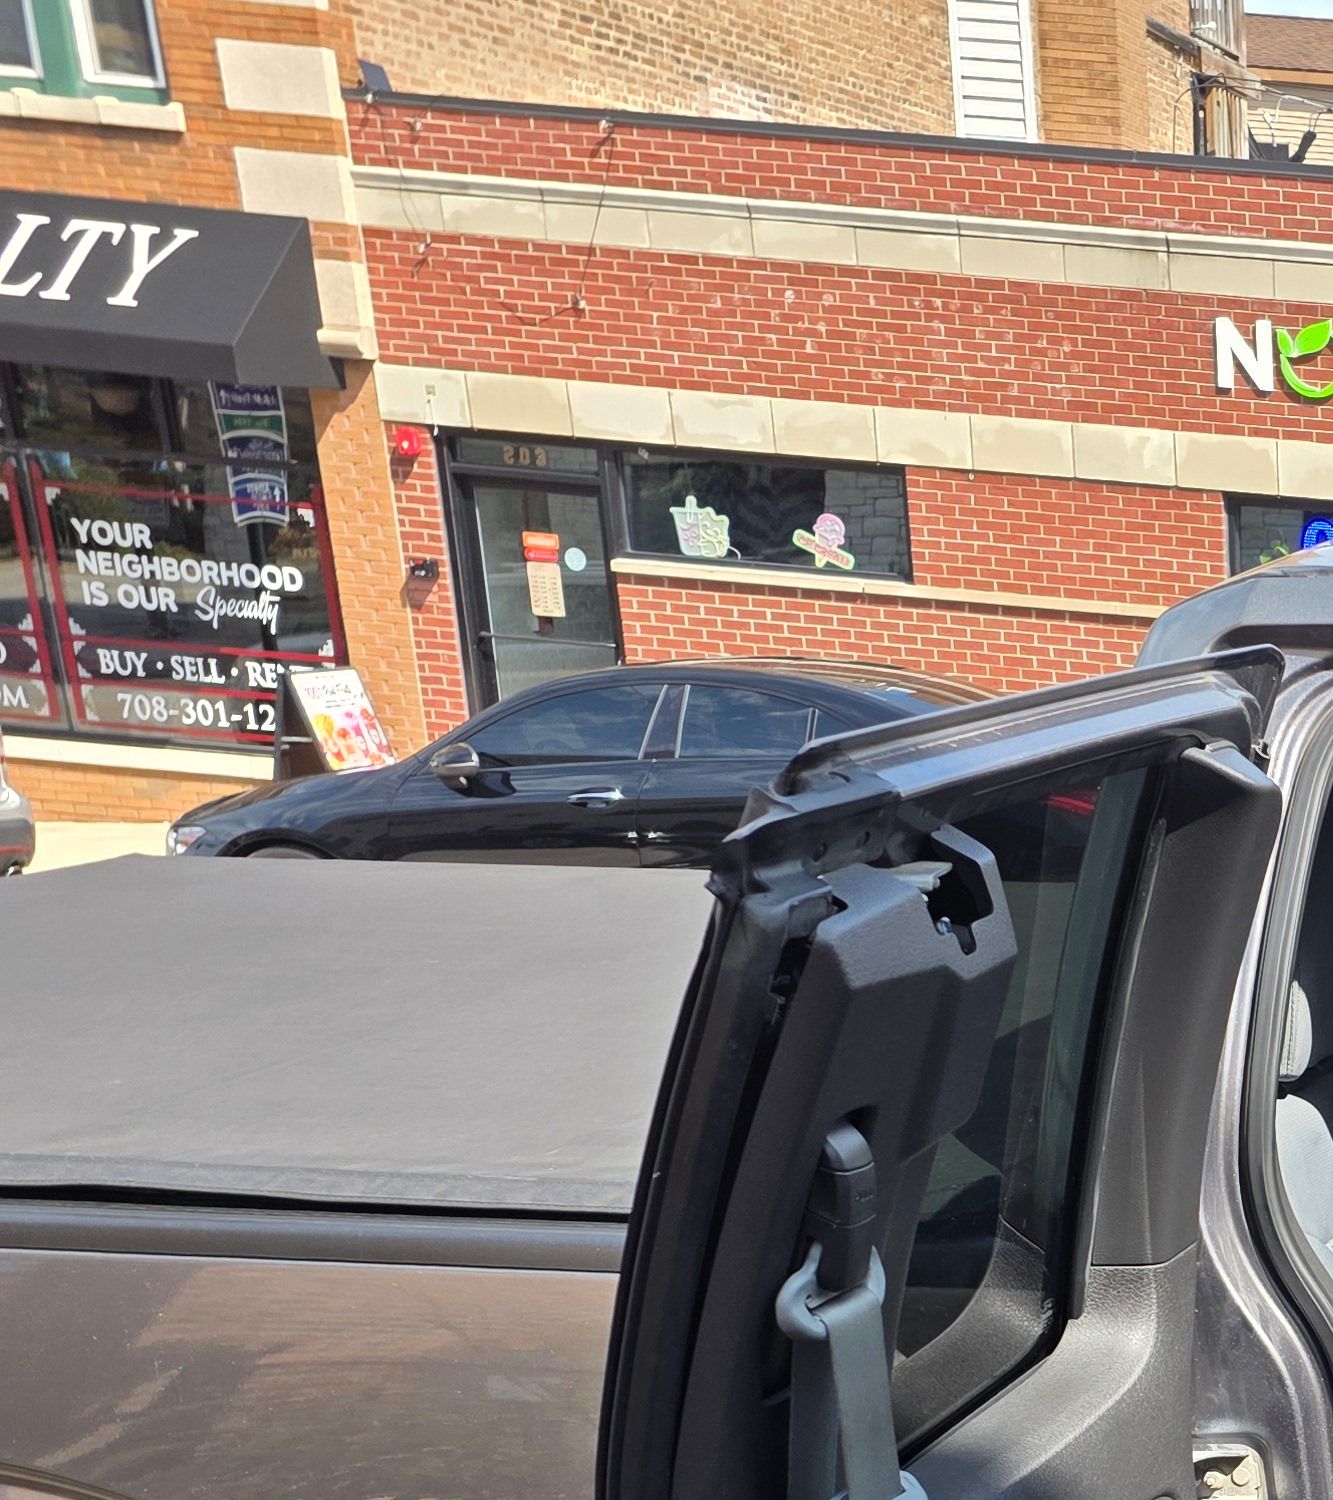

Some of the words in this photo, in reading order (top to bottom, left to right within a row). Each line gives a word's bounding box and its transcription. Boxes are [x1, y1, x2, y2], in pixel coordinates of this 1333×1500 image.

[0, 213, 200, 307] LTY
[70, 517, 153, 549] YOUR
[75, 549, 303, 593] NEIGHBORHOOD
[81, 580, 109, 607] IS
[117, 584, 178, 613] OUR
[194, 585, 281, 635] Specialty
[97, 648, 148, 678] BUY
[170, 655, 226, 684] SELL
